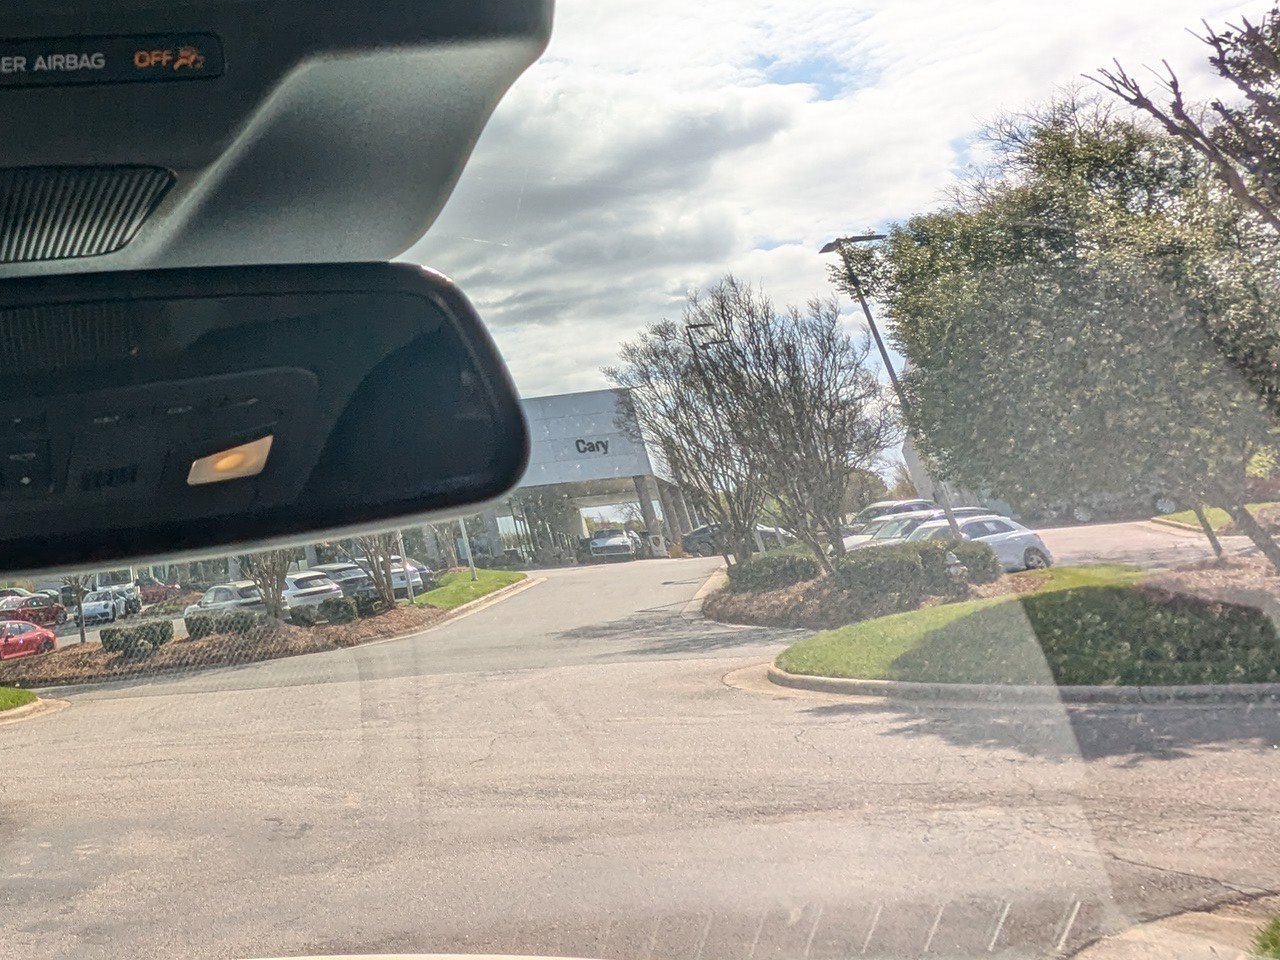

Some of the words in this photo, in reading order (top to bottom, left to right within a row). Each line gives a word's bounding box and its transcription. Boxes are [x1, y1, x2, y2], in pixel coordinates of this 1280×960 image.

[33, 52, 106, 72] AIRBAG
[132, 49, 172, 69] OFF
[575, 439, 609, 455] Cary
